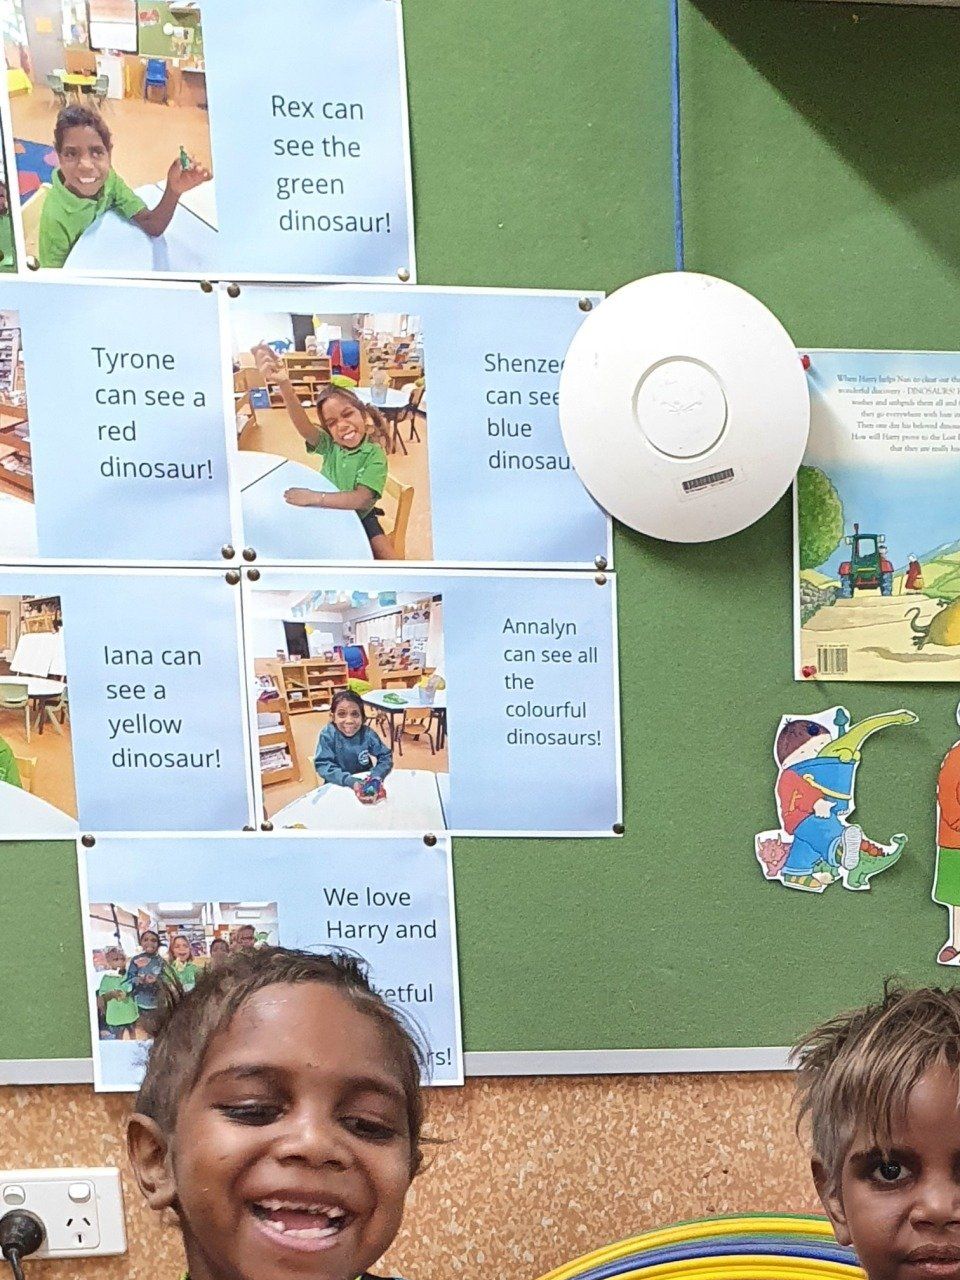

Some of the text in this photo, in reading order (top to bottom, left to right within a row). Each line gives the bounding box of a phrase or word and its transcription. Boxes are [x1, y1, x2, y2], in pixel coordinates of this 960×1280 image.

[272, 95, 363, 120] Rex can
[274, 135, 360, 157] see the
[277, 177, 344, 199] green
[279, 210, 390, 233] dinosaur!
[91, 347, 174, 374] Tyrone
[95, 388, 206, 407] can see a
[486, 390, 521, 404] can
[98, 420, 136, 441] red
[488, 418, 532, 437] blue
[100, 456, 212, 479] dinosaur!
[502, 618, 577, 639] Annalyn
[162, 650, 201, 665] can
[504, 647, 597, 663] can see all
[505, 673, 534, 689] the
[107, 685, 166, 699] see a
[506, 701, 586, 718] colourful
[108, 713, 182, 739] yellow
[507, 729, 601, 745] dinosaurs!
[112, 748, 220, 768] dinosaur!
[323, 887, 411, 906] We love
[327, 920, 437, 944] Harry and
